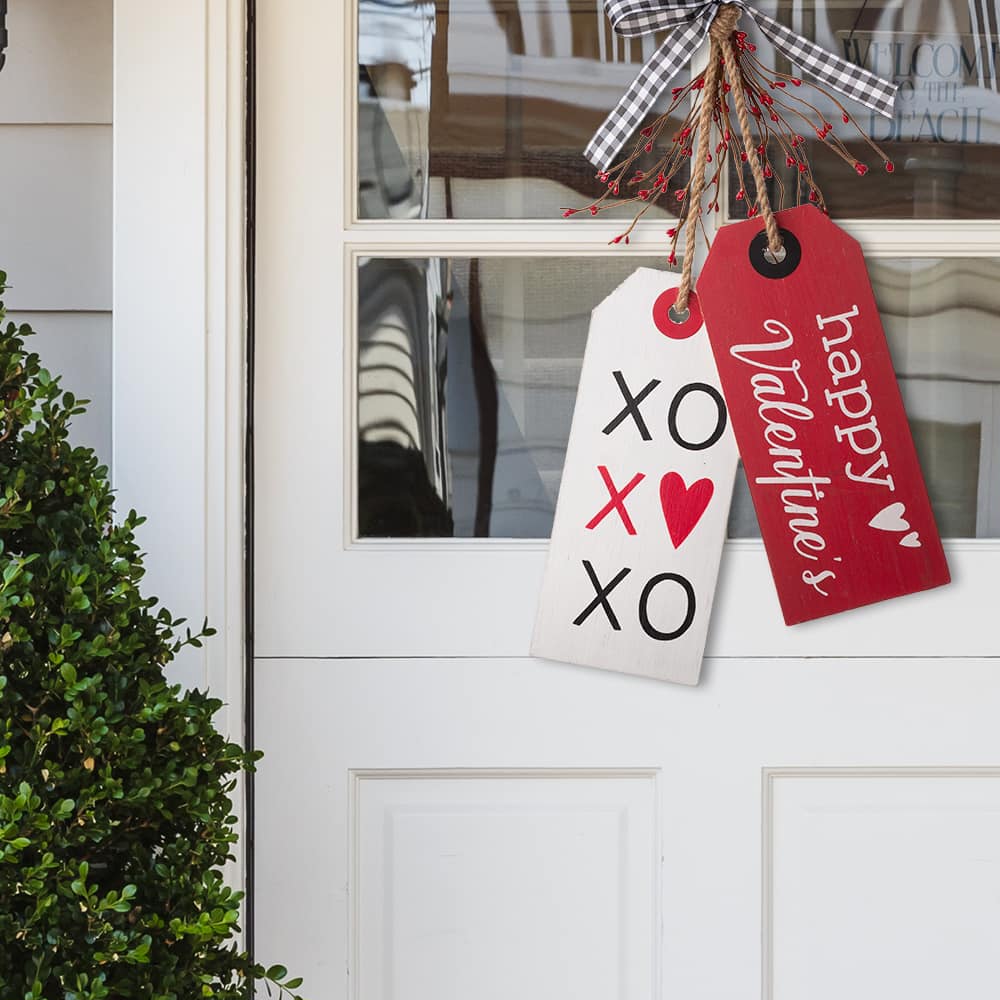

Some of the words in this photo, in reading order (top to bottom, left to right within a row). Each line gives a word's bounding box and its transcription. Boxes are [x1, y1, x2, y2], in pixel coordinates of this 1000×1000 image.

[868, 107, 983, 144] BEACH
[602, 371, 727, 451] XO
[816, 304, 895, 492] happy
[730, 319, 842, 597] Valentine's
[572, 560, 697, 641] XO
